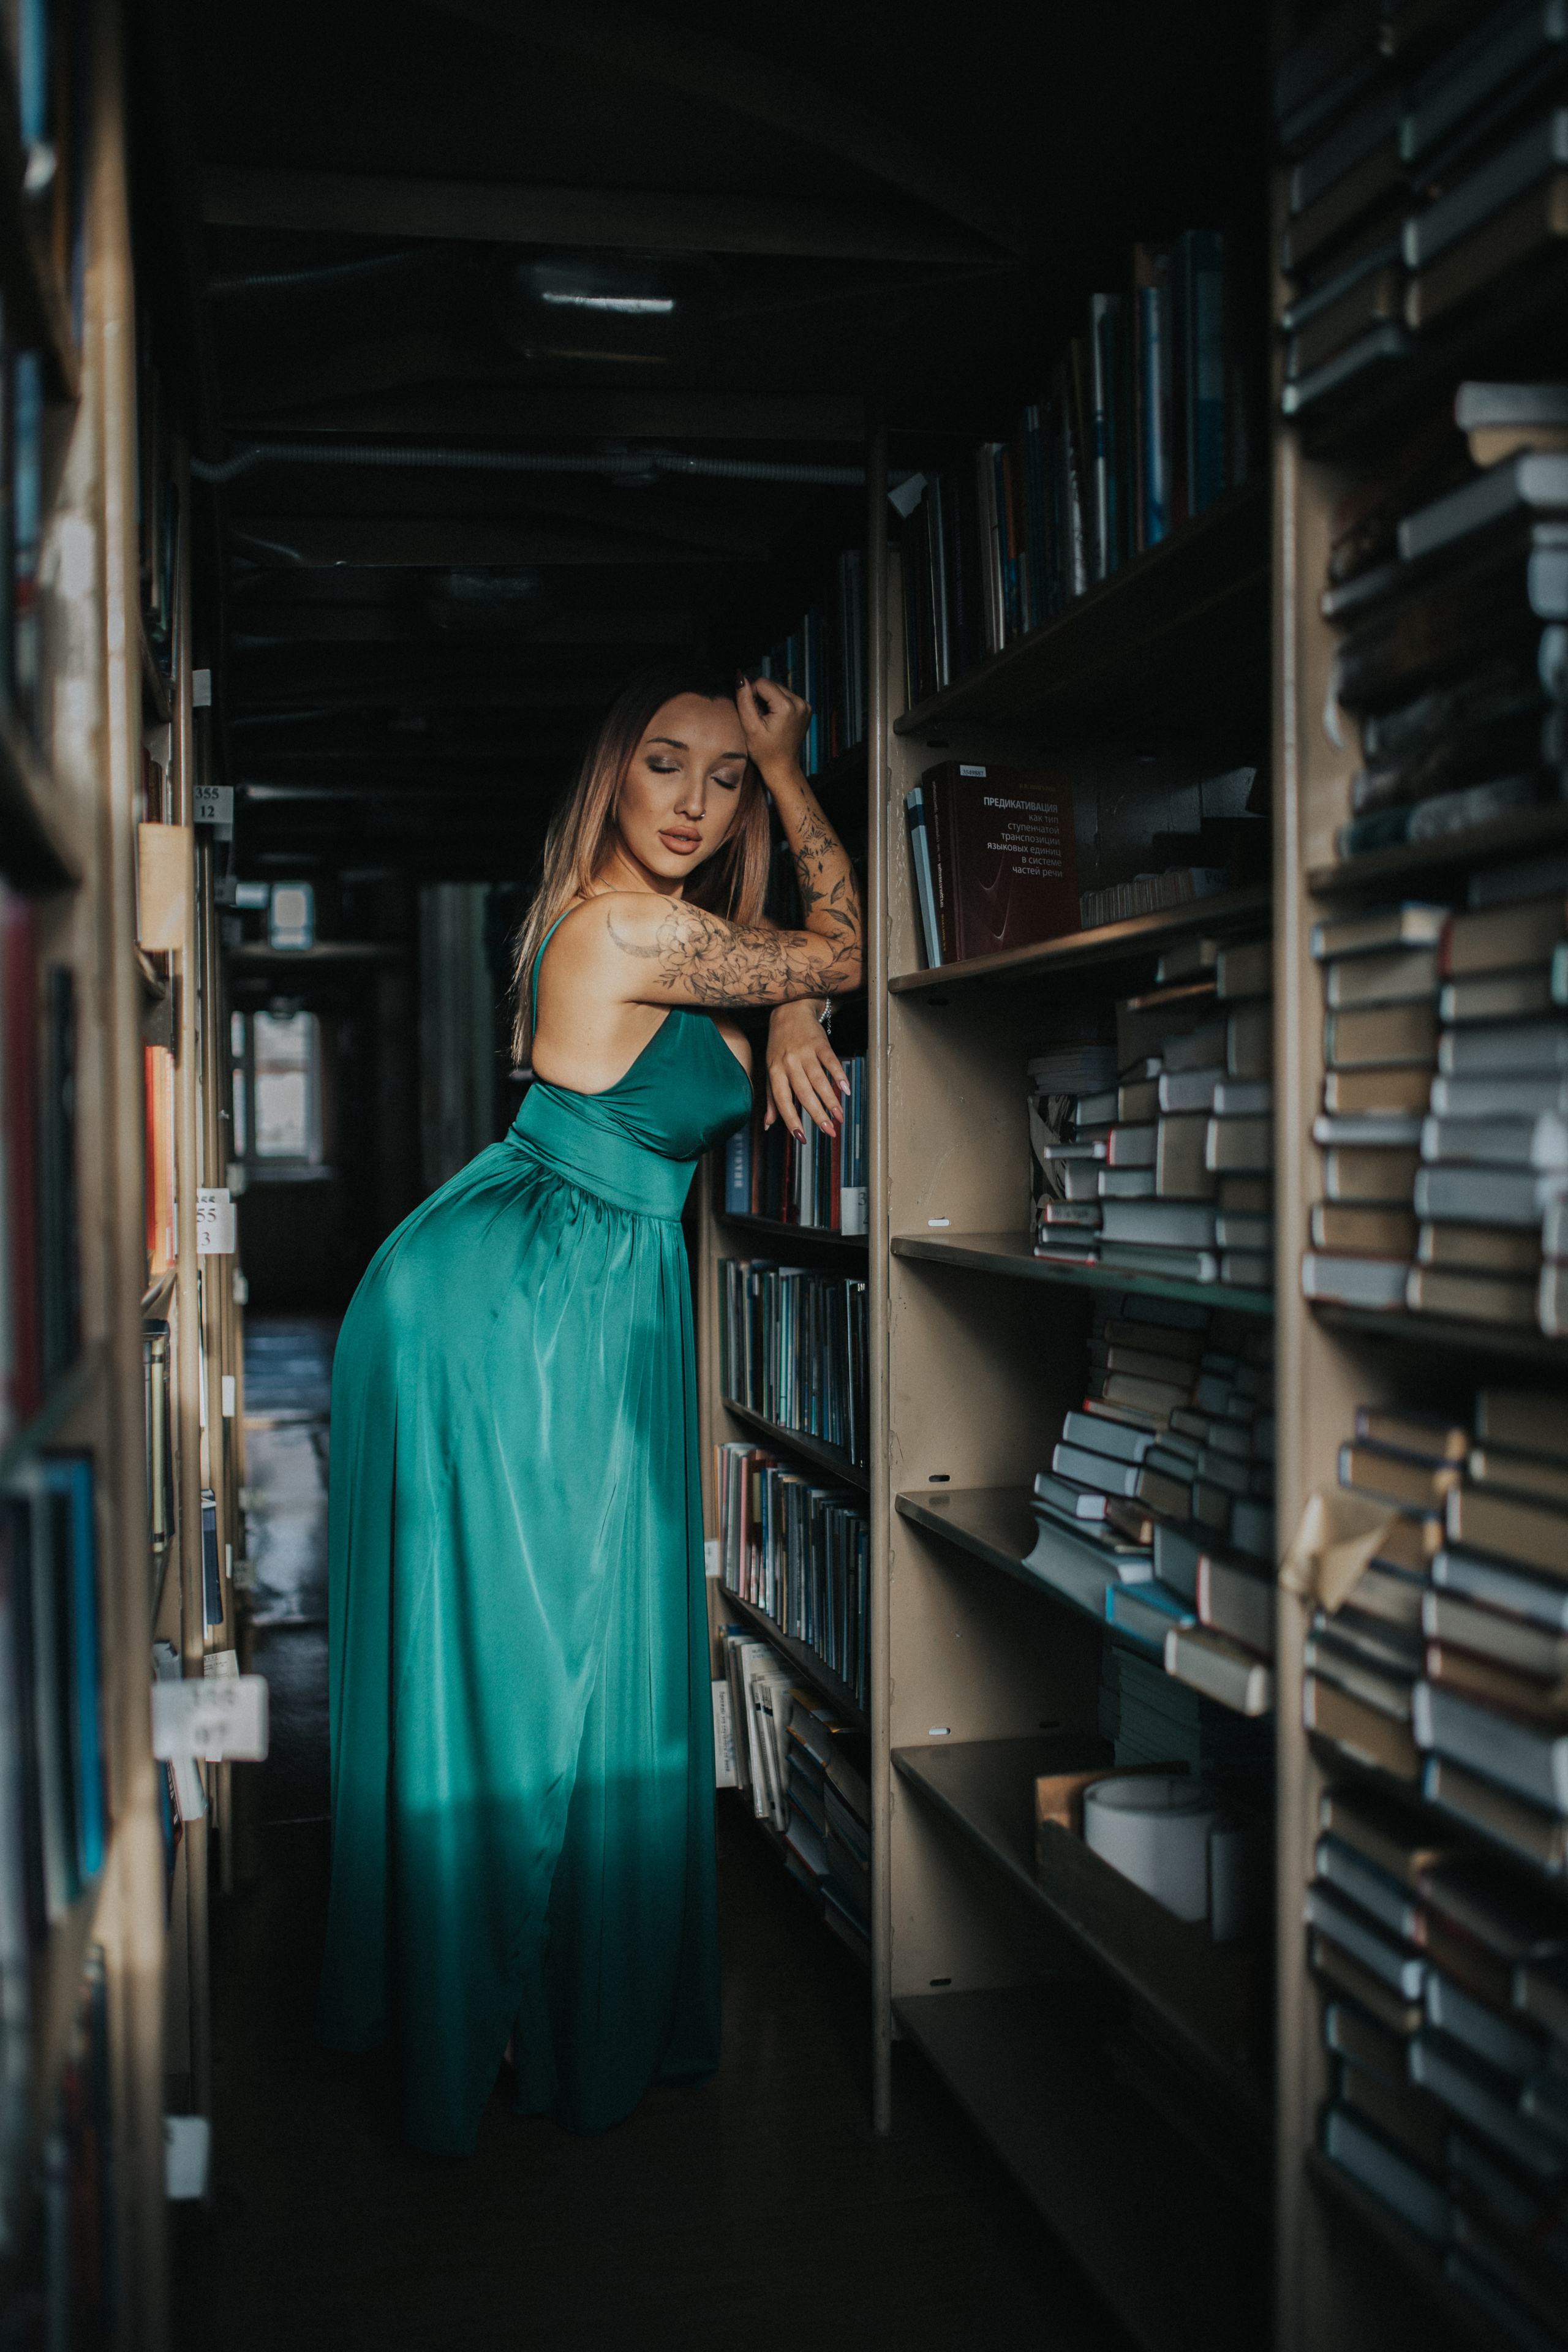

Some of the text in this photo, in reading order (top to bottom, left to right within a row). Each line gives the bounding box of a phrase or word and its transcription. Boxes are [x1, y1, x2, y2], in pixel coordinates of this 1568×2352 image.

[195, 787, 219, 799] 355
[984, 796, 1058, 813] ПРЕДИКАТИВАЦИЯ
[201, 805, 214, 817] 12
[1008, 823, 1060, 834] ступенчатой
[1001, 832, 1060, 845] транспозиции
[987, 842, 1061, 857] языковых единиц
[1028, 857, 1062, 867] системе
[1012, 866, 1040, 875] частей
